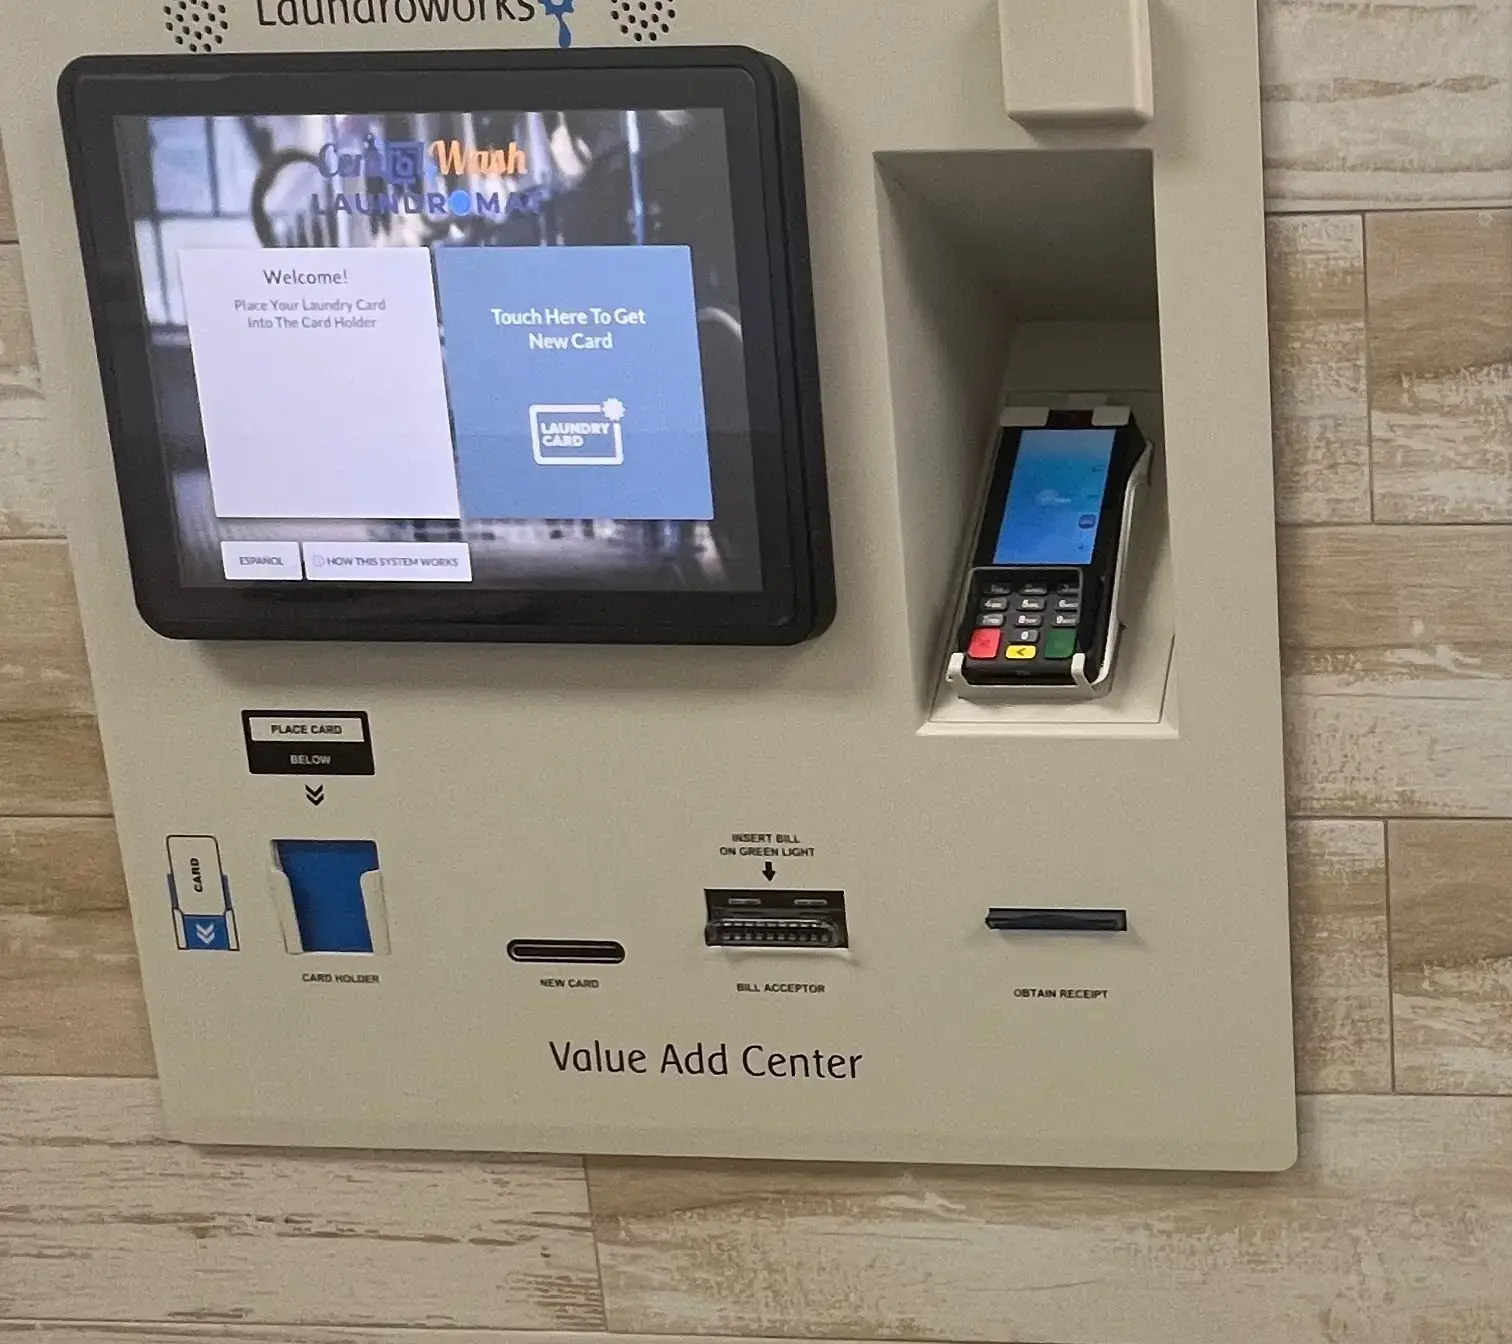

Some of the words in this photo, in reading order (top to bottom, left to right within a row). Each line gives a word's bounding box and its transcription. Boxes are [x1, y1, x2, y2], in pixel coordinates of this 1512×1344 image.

[428, 140, 528, 175] Wash
[262, 268, 349, 285] Welcome!
[235, 299, 268, 311] Place
[269, 299, 299, 311] Your
[302, 298, 352, 313] Laundry
[356, 299, 386, 311] Card
[490, 308, 542, 325] Touch
[544, 308, 588, 325] Here
[589, 307, 612, 325] To
[614, 307, 647, 325] Get
[247, 316, 273, 329] Into
[274, 316, 299, 328] The
[302, 316, 332, 328] Card
[334, 316, 376, 328] Holder
[528, 332, 568, 349] New
[571, 332, 613, 349] Card
[540, 422, 610, 434] LAUNDRY
[542, 435, 584, 447] CARD
[327, 557, 353, 566] HOW
[355, 557, 378, 566] THIS
[379, 557, 418, 567] SYSTEM
[421, 557, 458, 567] WORKS
[271, 724, 308, 734] PLACE
[310, 724, 342, 734] CARD
[290, 754, 331, 764] BELOW
[731, 833, 772, 843] INSERT
[775, 834, 801, 843] BILL
[719, 846, 736, 855] ON
[739, 846, 779, 856] GREEN
[781, 847, 815, 857] LIGHT
[190, 857, 204, 893] CARD
[302, 973, 332, 983] CARD
[335, 974, 380, 984] HOLDER
[540, 978, 565, 987] NEW
[568, 978, 599, 988] CARD
[736, 982, 761, 992] BILL
[763, 983, 825, 993] ACCEPTOR
[1013, 988, 1057, 998] OBTAIN
[1059, 989, 1108, 999] RECEIPT
[548, 1039, 647, 1073] Value
[660, 1042, 729, 1076] Add
[742, 1044, 863, 1079] Center
